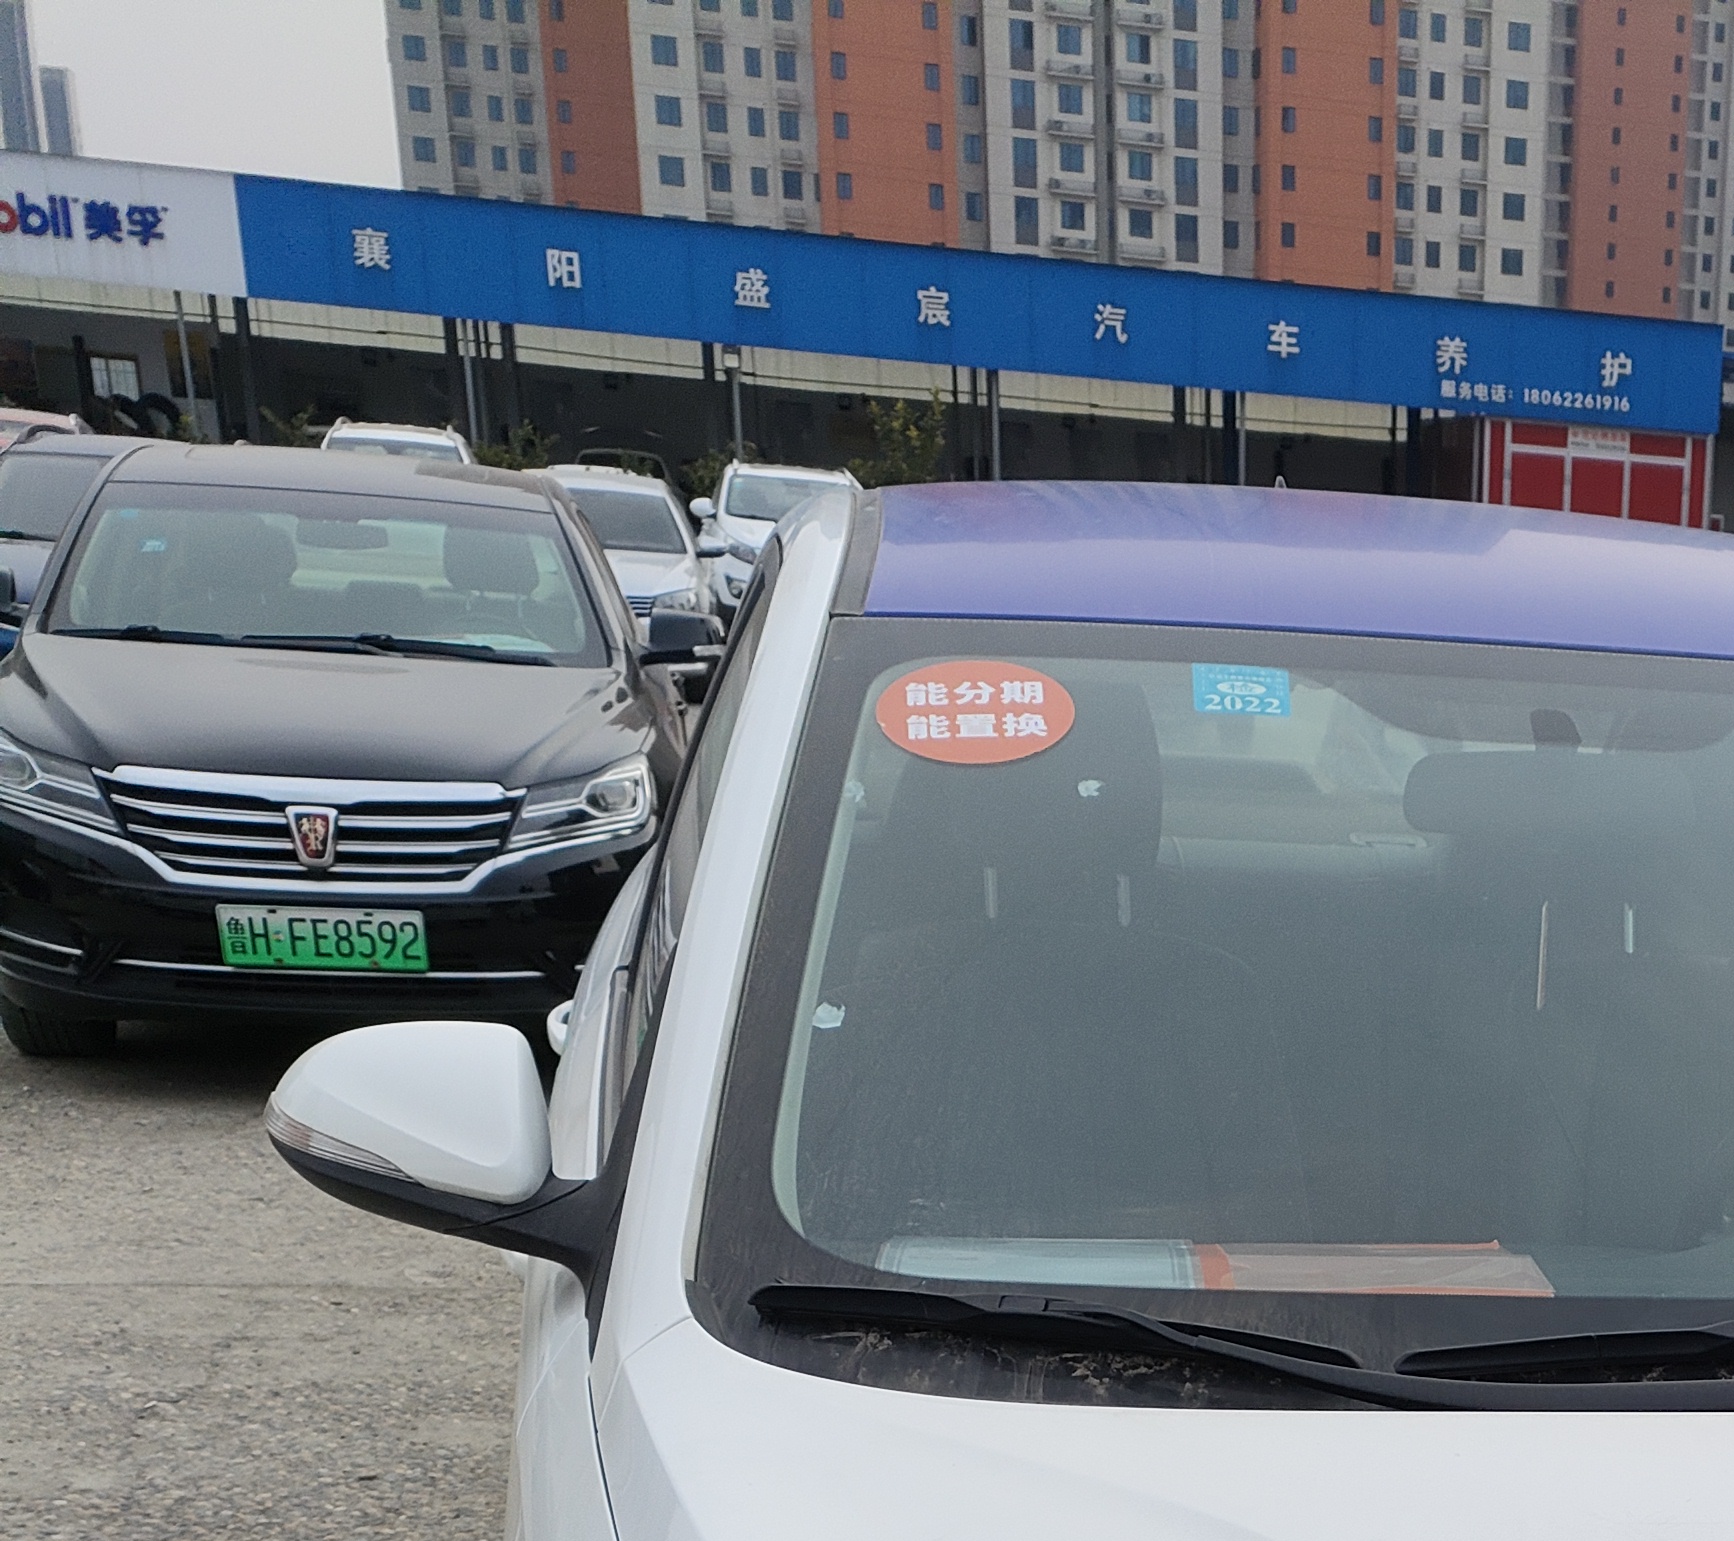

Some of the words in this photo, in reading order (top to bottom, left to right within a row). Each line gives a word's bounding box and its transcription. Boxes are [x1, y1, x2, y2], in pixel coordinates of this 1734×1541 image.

[83, 199, 165, 246] 美孚
[905, 680, 1045, 706] 能分期
[1204, 694, 1282, 713] 2022
[906, 713, 1048, 739] 能置换
